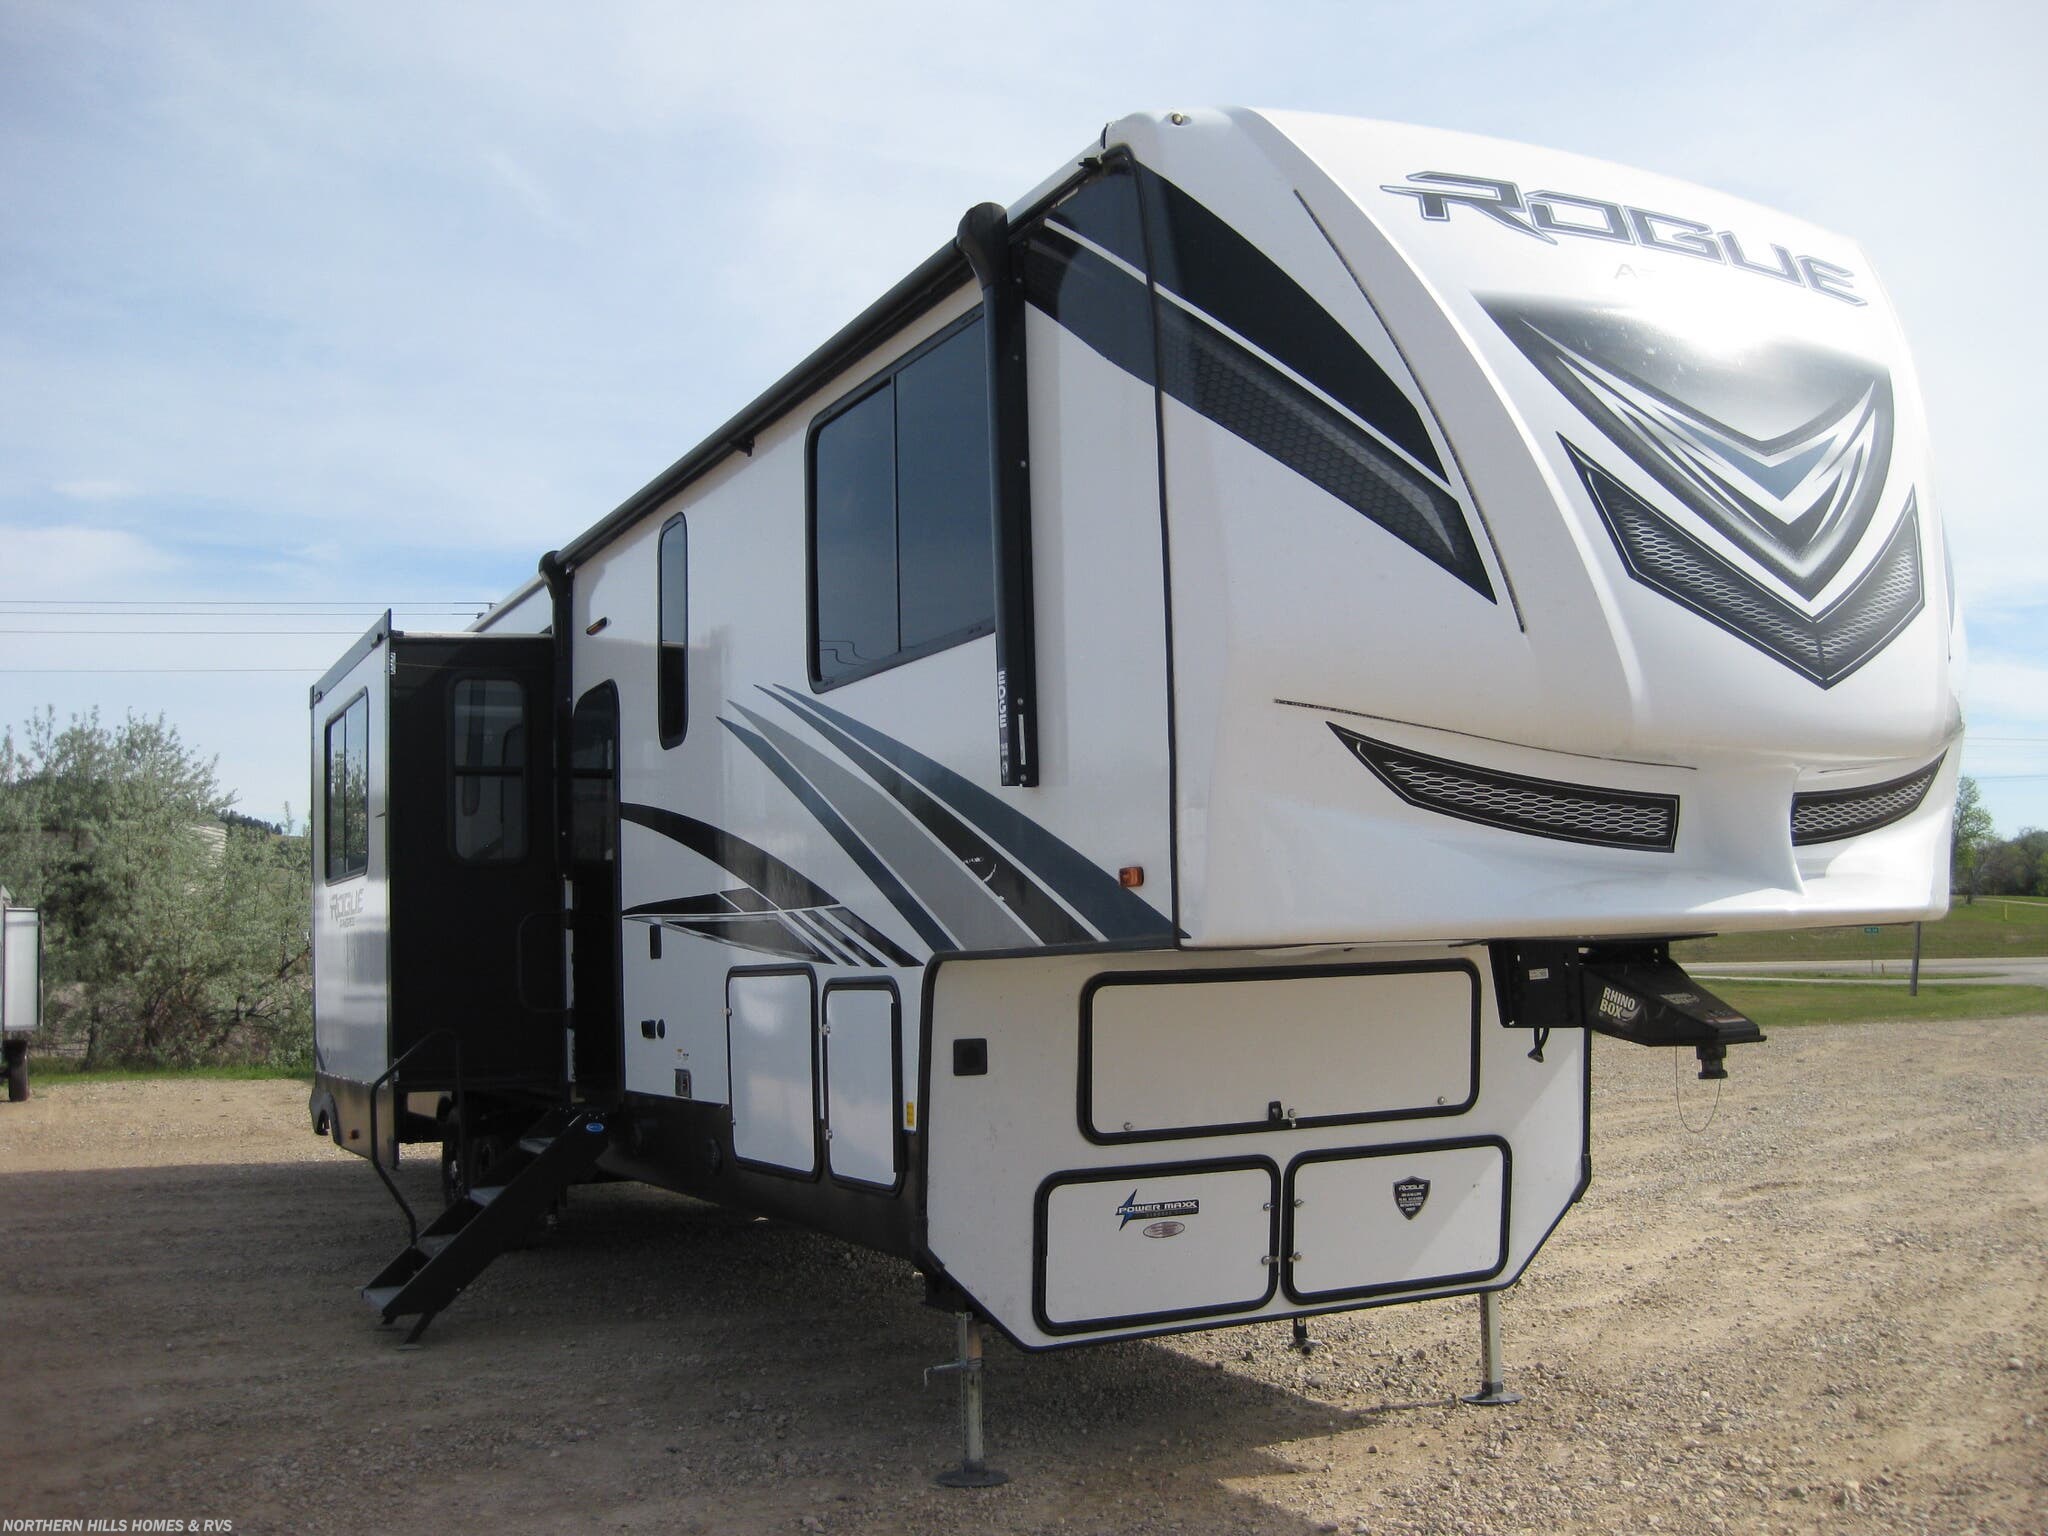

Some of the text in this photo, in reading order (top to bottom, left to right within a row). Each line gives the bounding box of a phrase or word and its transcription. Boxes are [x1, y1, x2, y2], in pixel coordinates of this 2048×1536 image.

[1381, 171, 1868, 306] ROGUE
[1599, 998, 1623, 1019] BOX
[1602, 986, 1636, 1010] RHINO
[1118, 1203, 1161, 1214] POWER
[1164, 1200, 1197, 1210] MAXX
